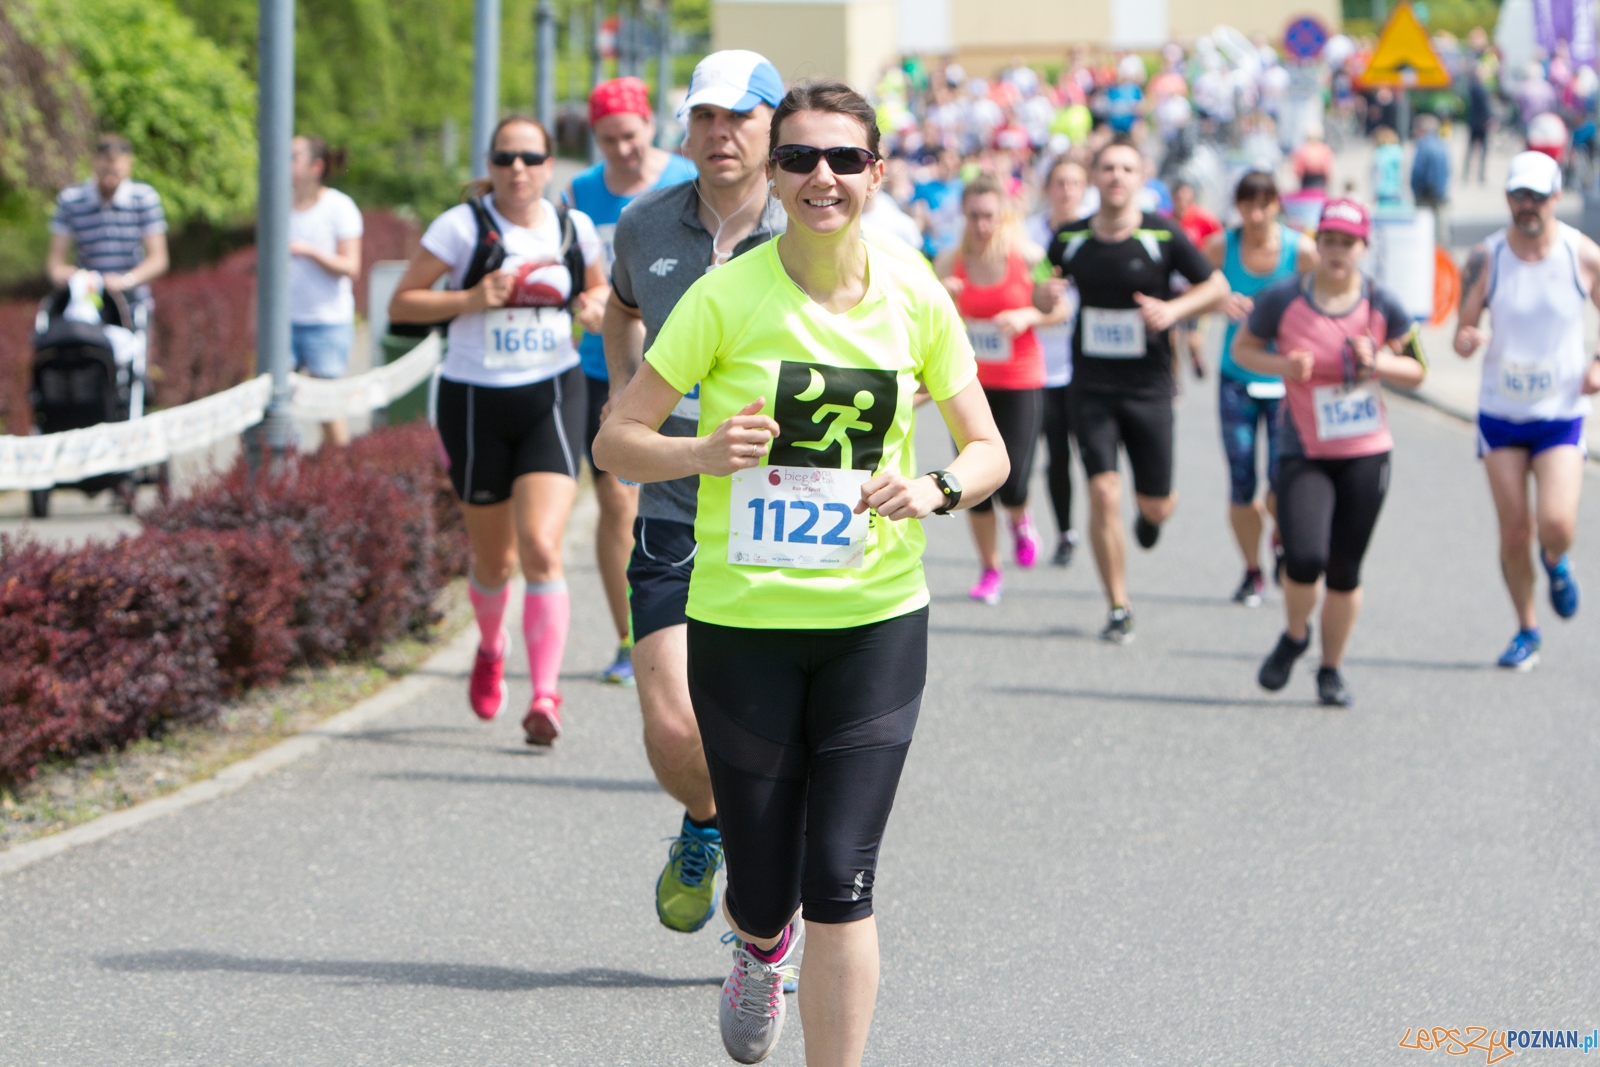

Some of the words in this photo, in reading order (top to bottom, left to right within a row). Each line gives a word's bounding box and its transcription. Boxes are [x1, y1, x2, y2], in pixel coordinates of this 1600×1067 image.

[649, 257, 678, 277] 4F
[492, 328, 555, 352] 1668
[1322, 396, 1377, 425] 1526
[784, 469, 809, 486] bieg
[748, 498, 852, 546] 1122
